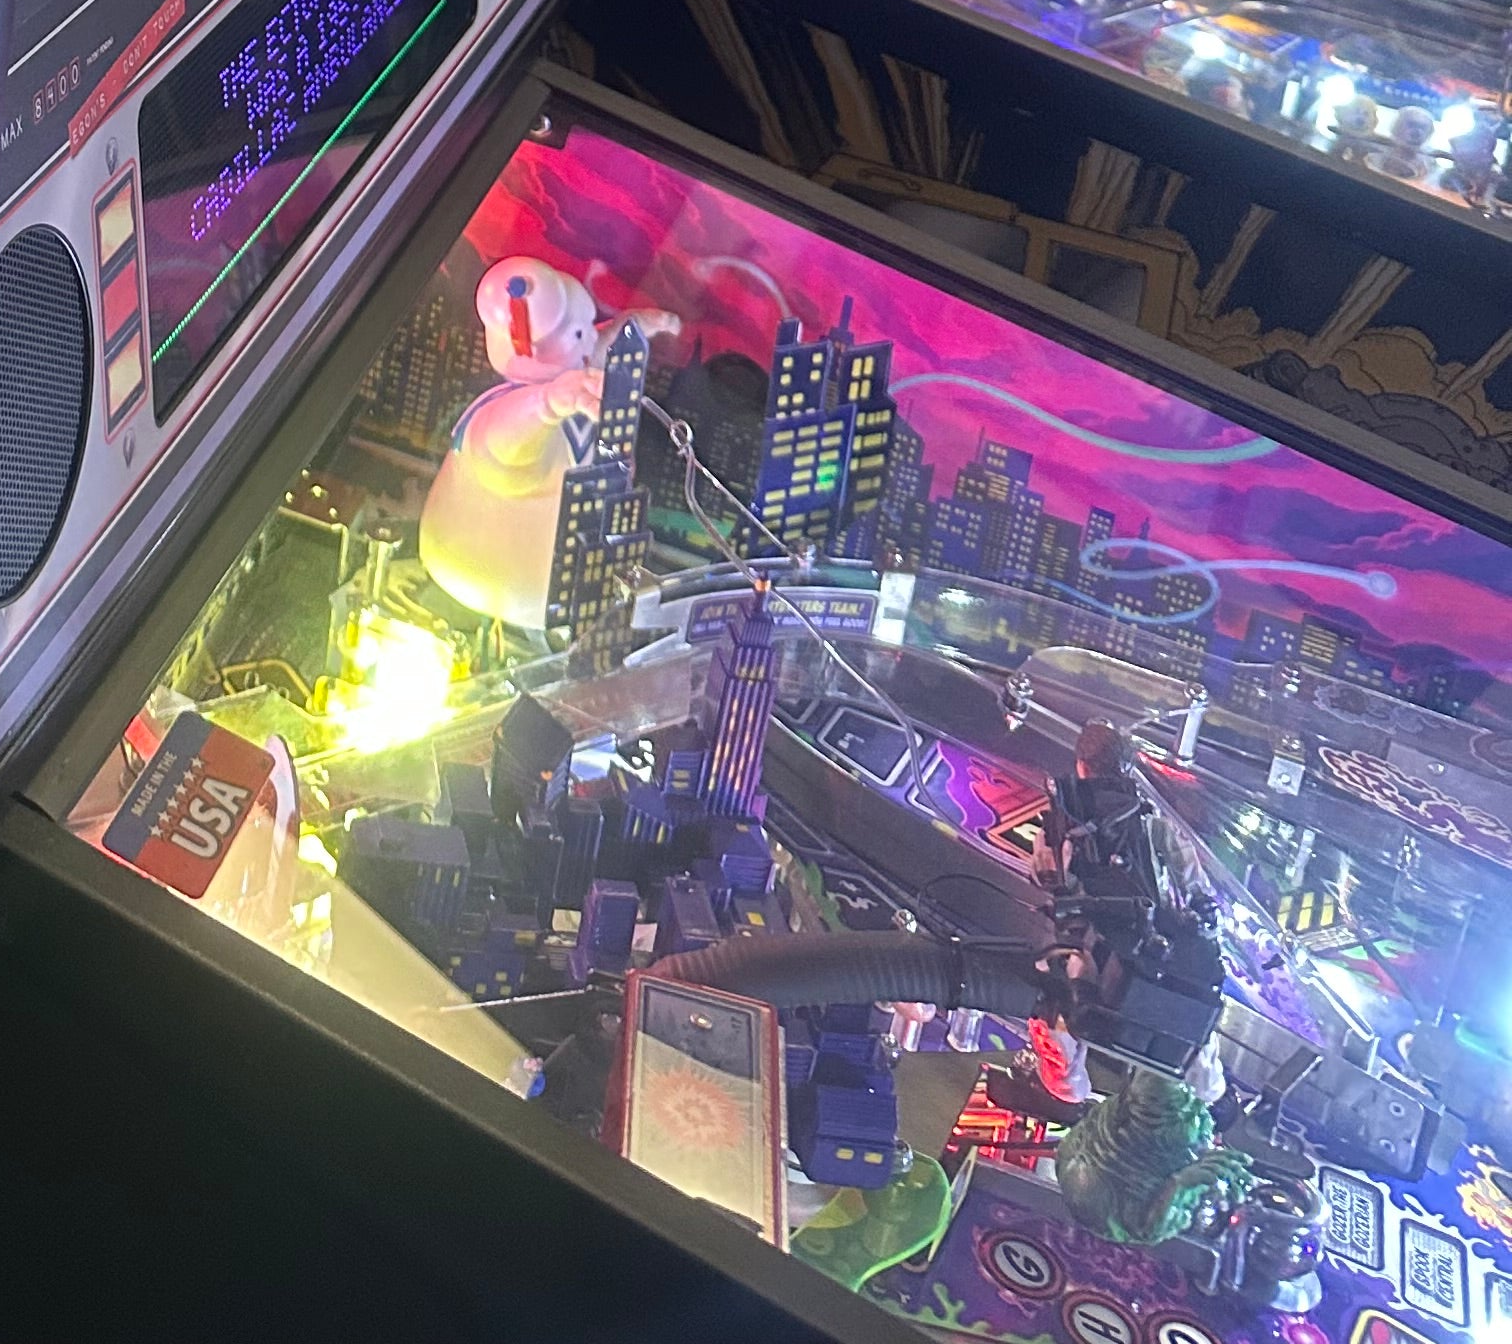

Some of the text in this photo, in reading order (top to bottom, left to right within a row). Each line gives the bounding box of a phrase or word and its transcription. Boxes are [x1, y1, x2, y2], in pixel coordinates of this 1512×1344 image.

[70, 92, 107, 145] EGON'S
[122, 36, 148, 74] DON'T
[219, 36, 260, 109] THE
[247, 68, 296, 130] WAS
[296, 33, 310, 75] A
[0, 115, 24, 151] MAX
[190, 107, 297, 241] CADILLAC
[131, 782, 159, 817] MADE
[159, 750, 178, 777] THE
[170, 777, 251, 859] USA
[1001, 1243, 1046, 1284] G
[1412, 1245, 1432, 1286] SPOOK
[1436, 1253, 1455, 1301] CENTRAL
